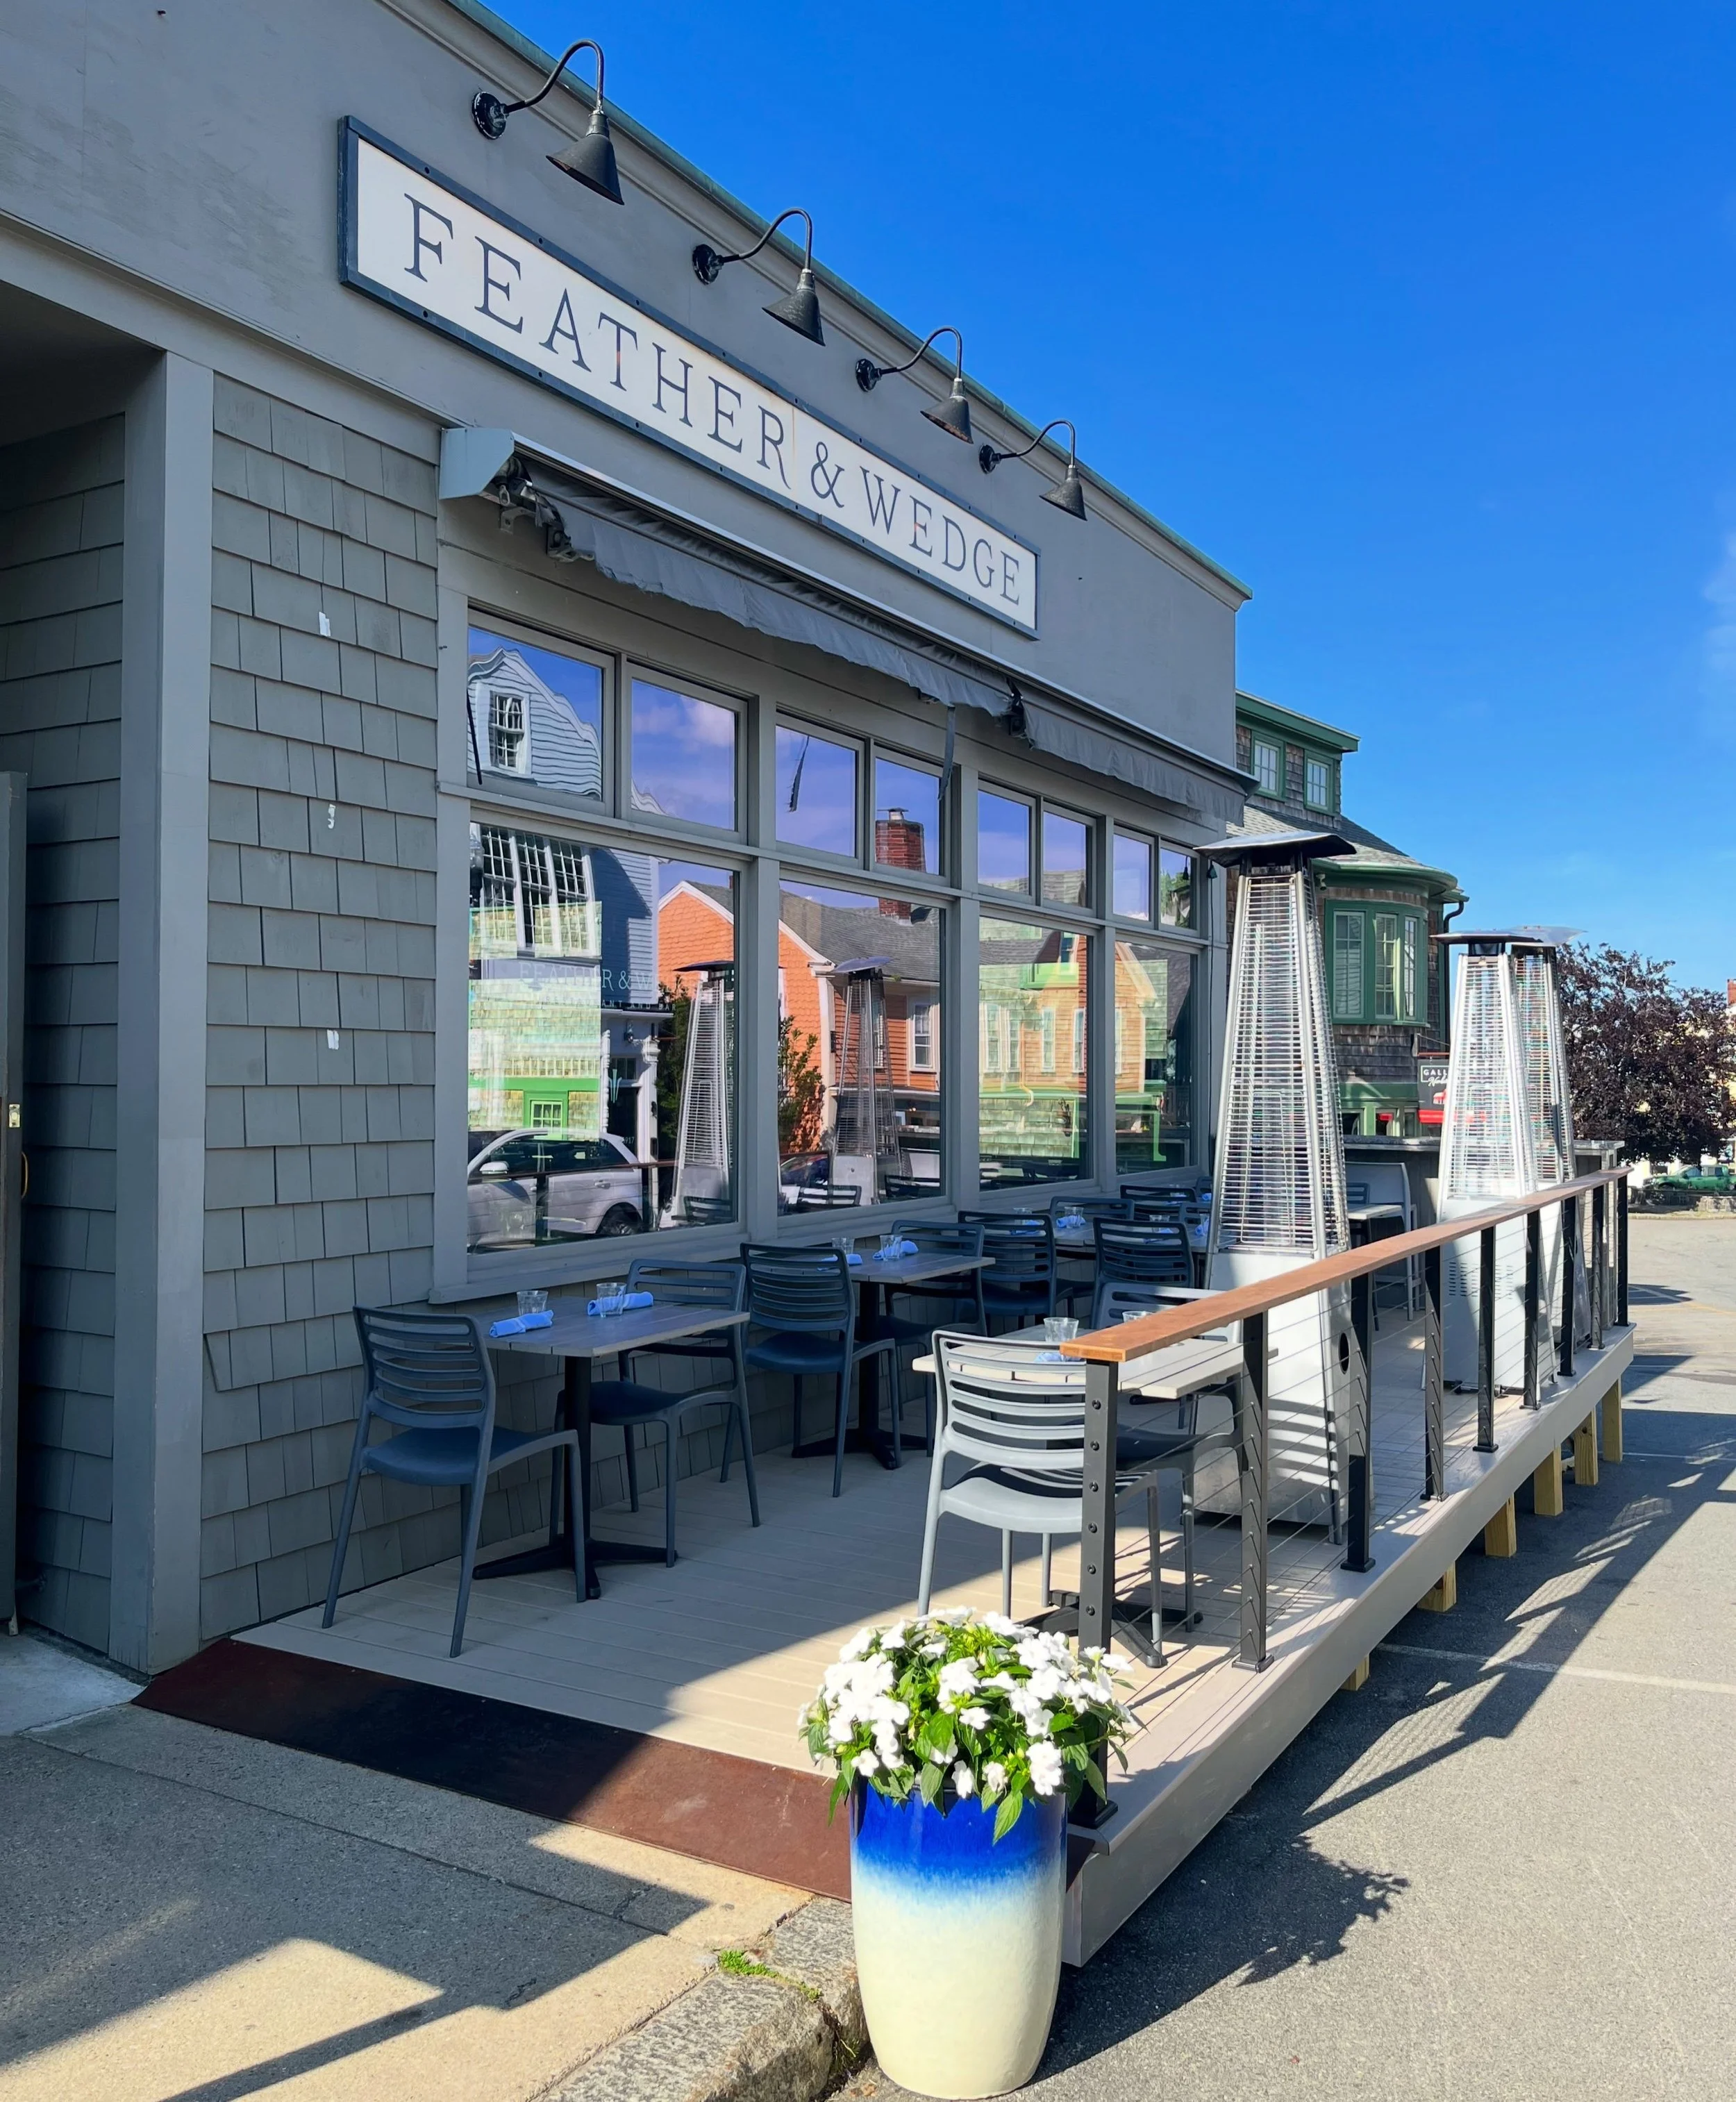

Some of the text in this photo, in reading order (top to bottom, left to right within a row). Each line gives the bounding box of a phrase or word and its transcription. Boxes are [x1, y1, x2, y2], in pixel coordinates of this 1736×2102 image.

[403, 192, 1019, 606] FEATHER & WEDGE
[618, 969, 631, 990] &
